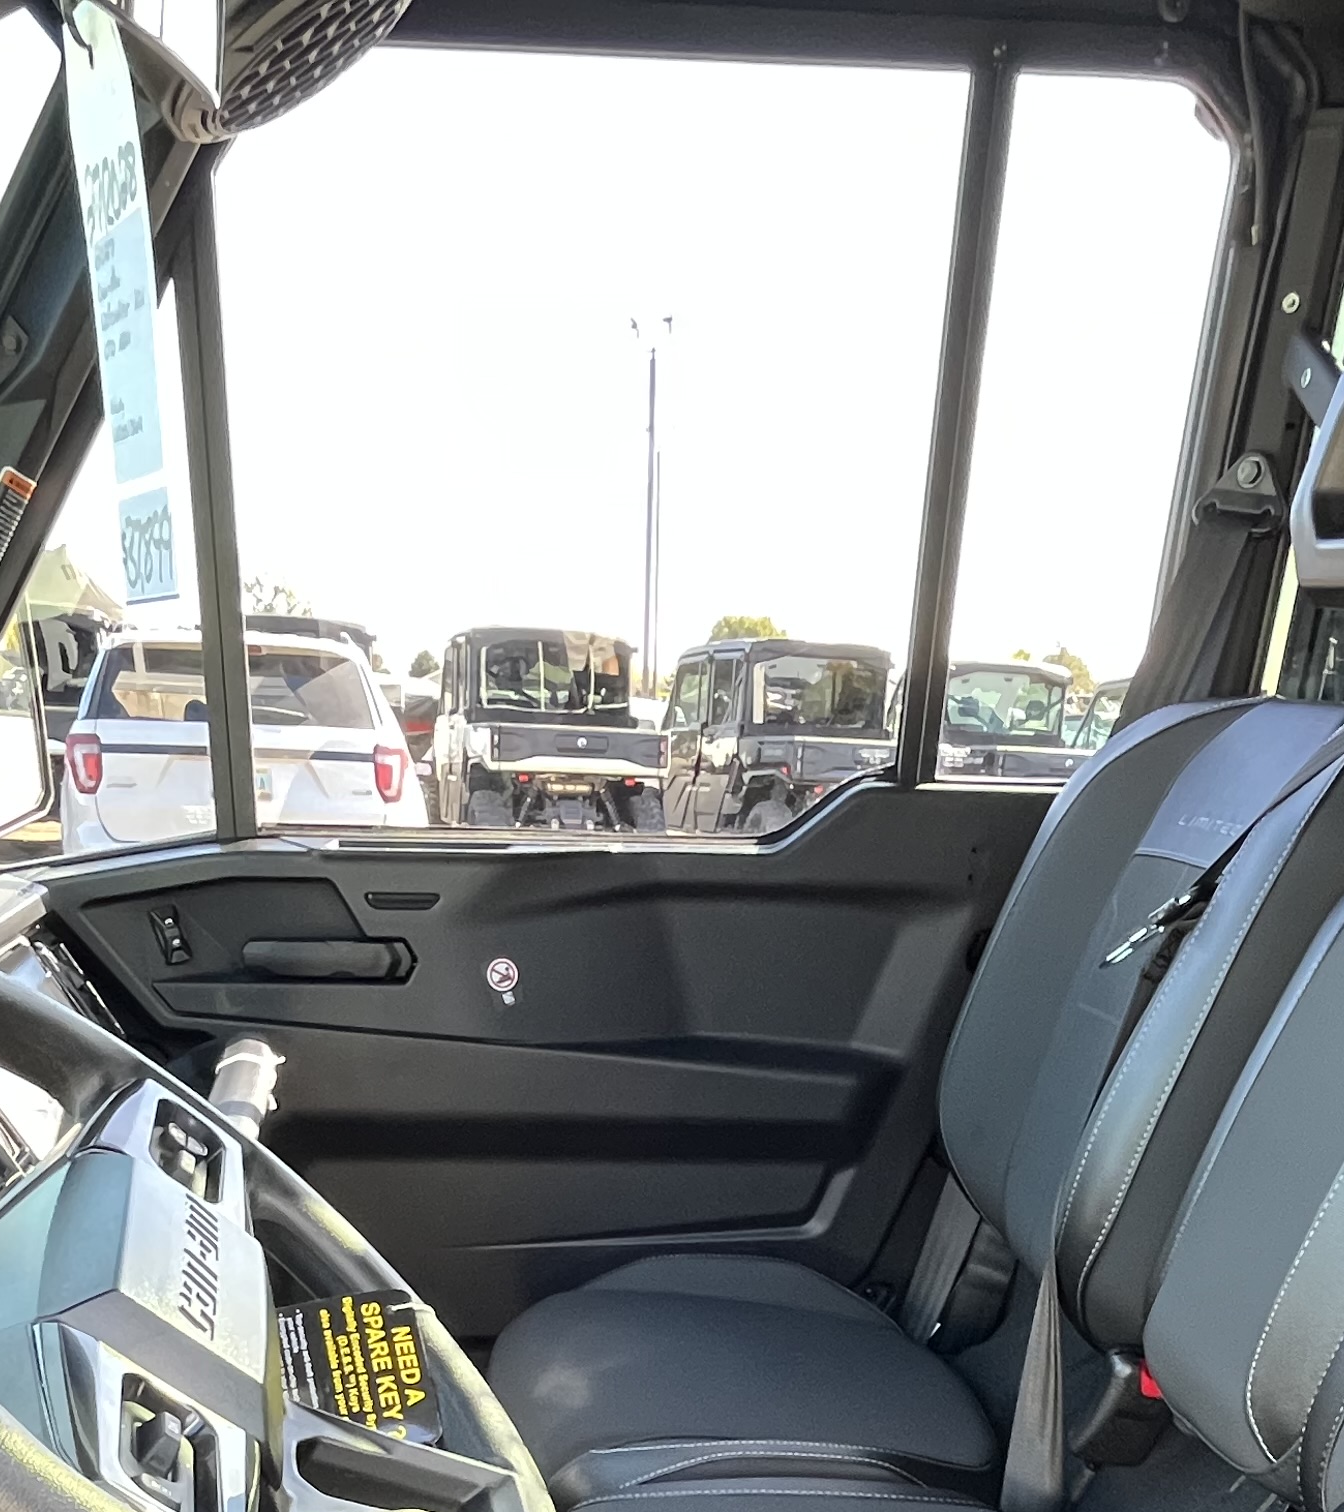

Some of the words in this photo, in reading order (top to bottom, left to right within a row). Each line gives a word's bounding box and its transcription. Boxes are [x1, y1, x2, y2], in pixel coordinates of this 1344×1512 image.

[360, 1301, 392, 1373] SPARE
[390, 1325, 421, 1385] NEED
[375, 1374, 404, 1420] KEY
[403, 1388, 426, 1407] A
